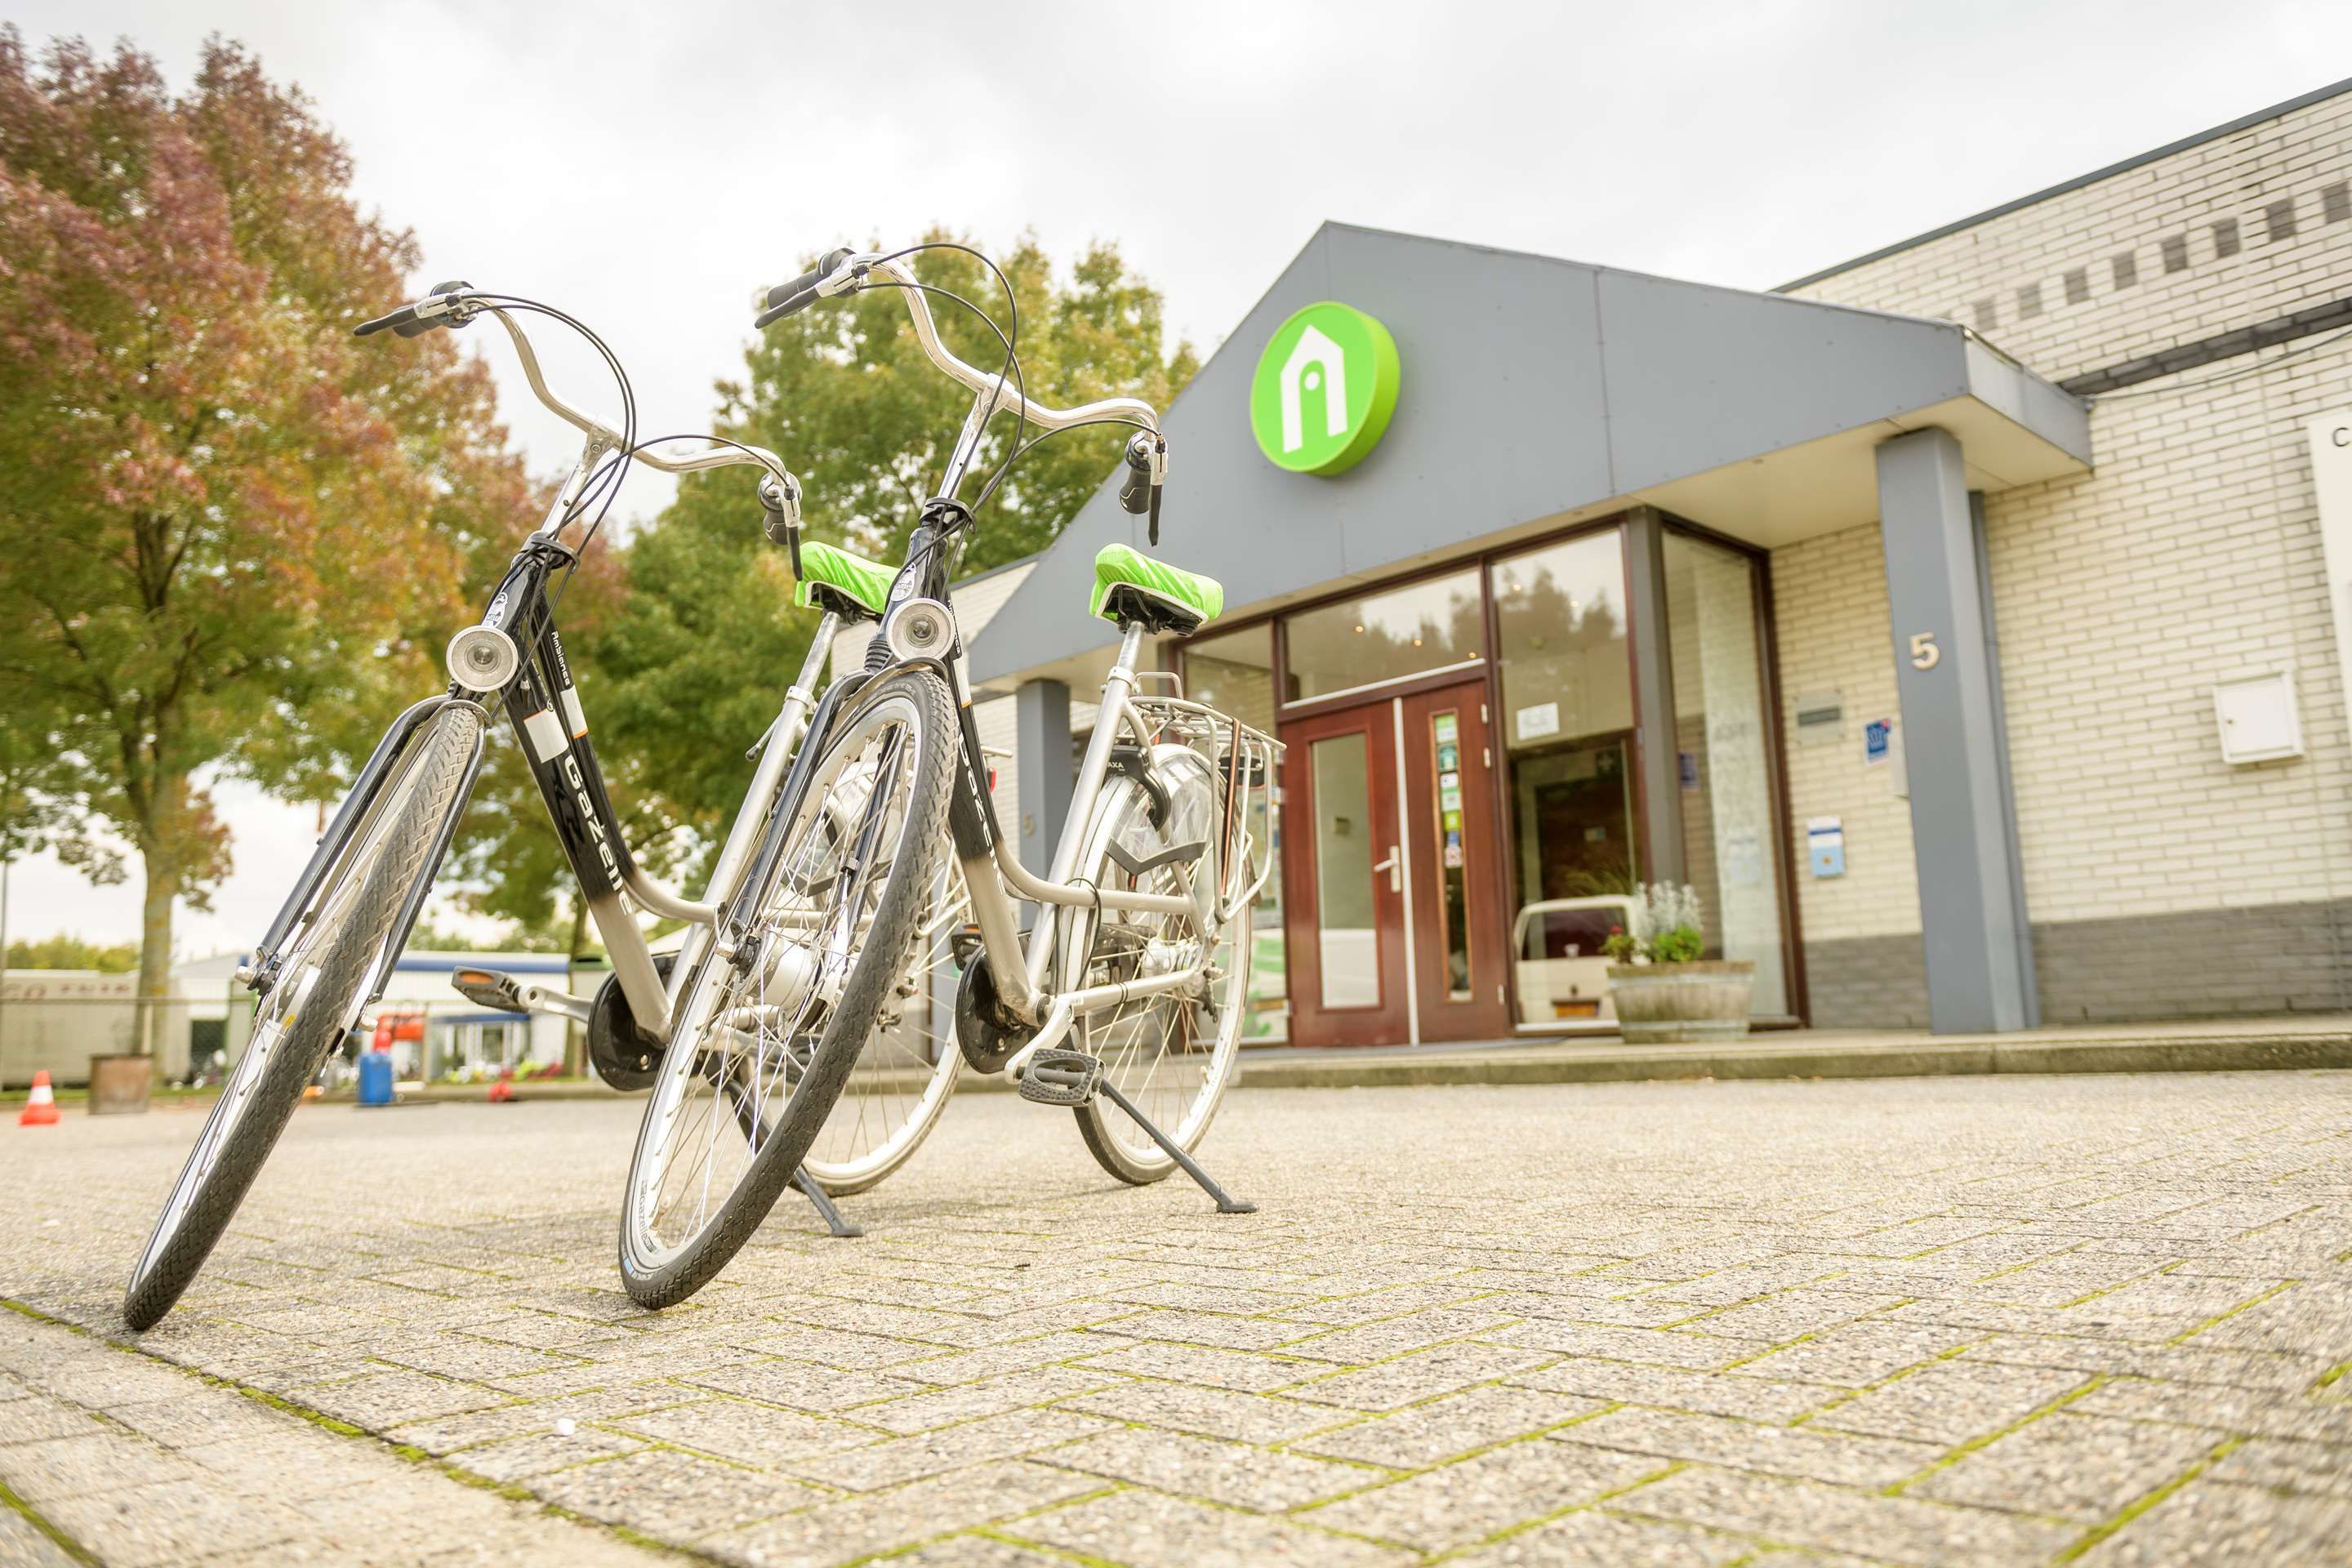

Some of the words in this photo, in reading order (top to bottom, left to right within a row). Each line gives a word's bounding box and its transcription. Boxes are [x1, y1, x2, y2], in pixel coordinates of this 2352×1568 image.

[551, 630, 571, 686] Ambiance
[1909, 631, 1940, 671] 5
[564, 754, 633, 915] Gazelle
[958, 731, 1006, 896] Gazelle
